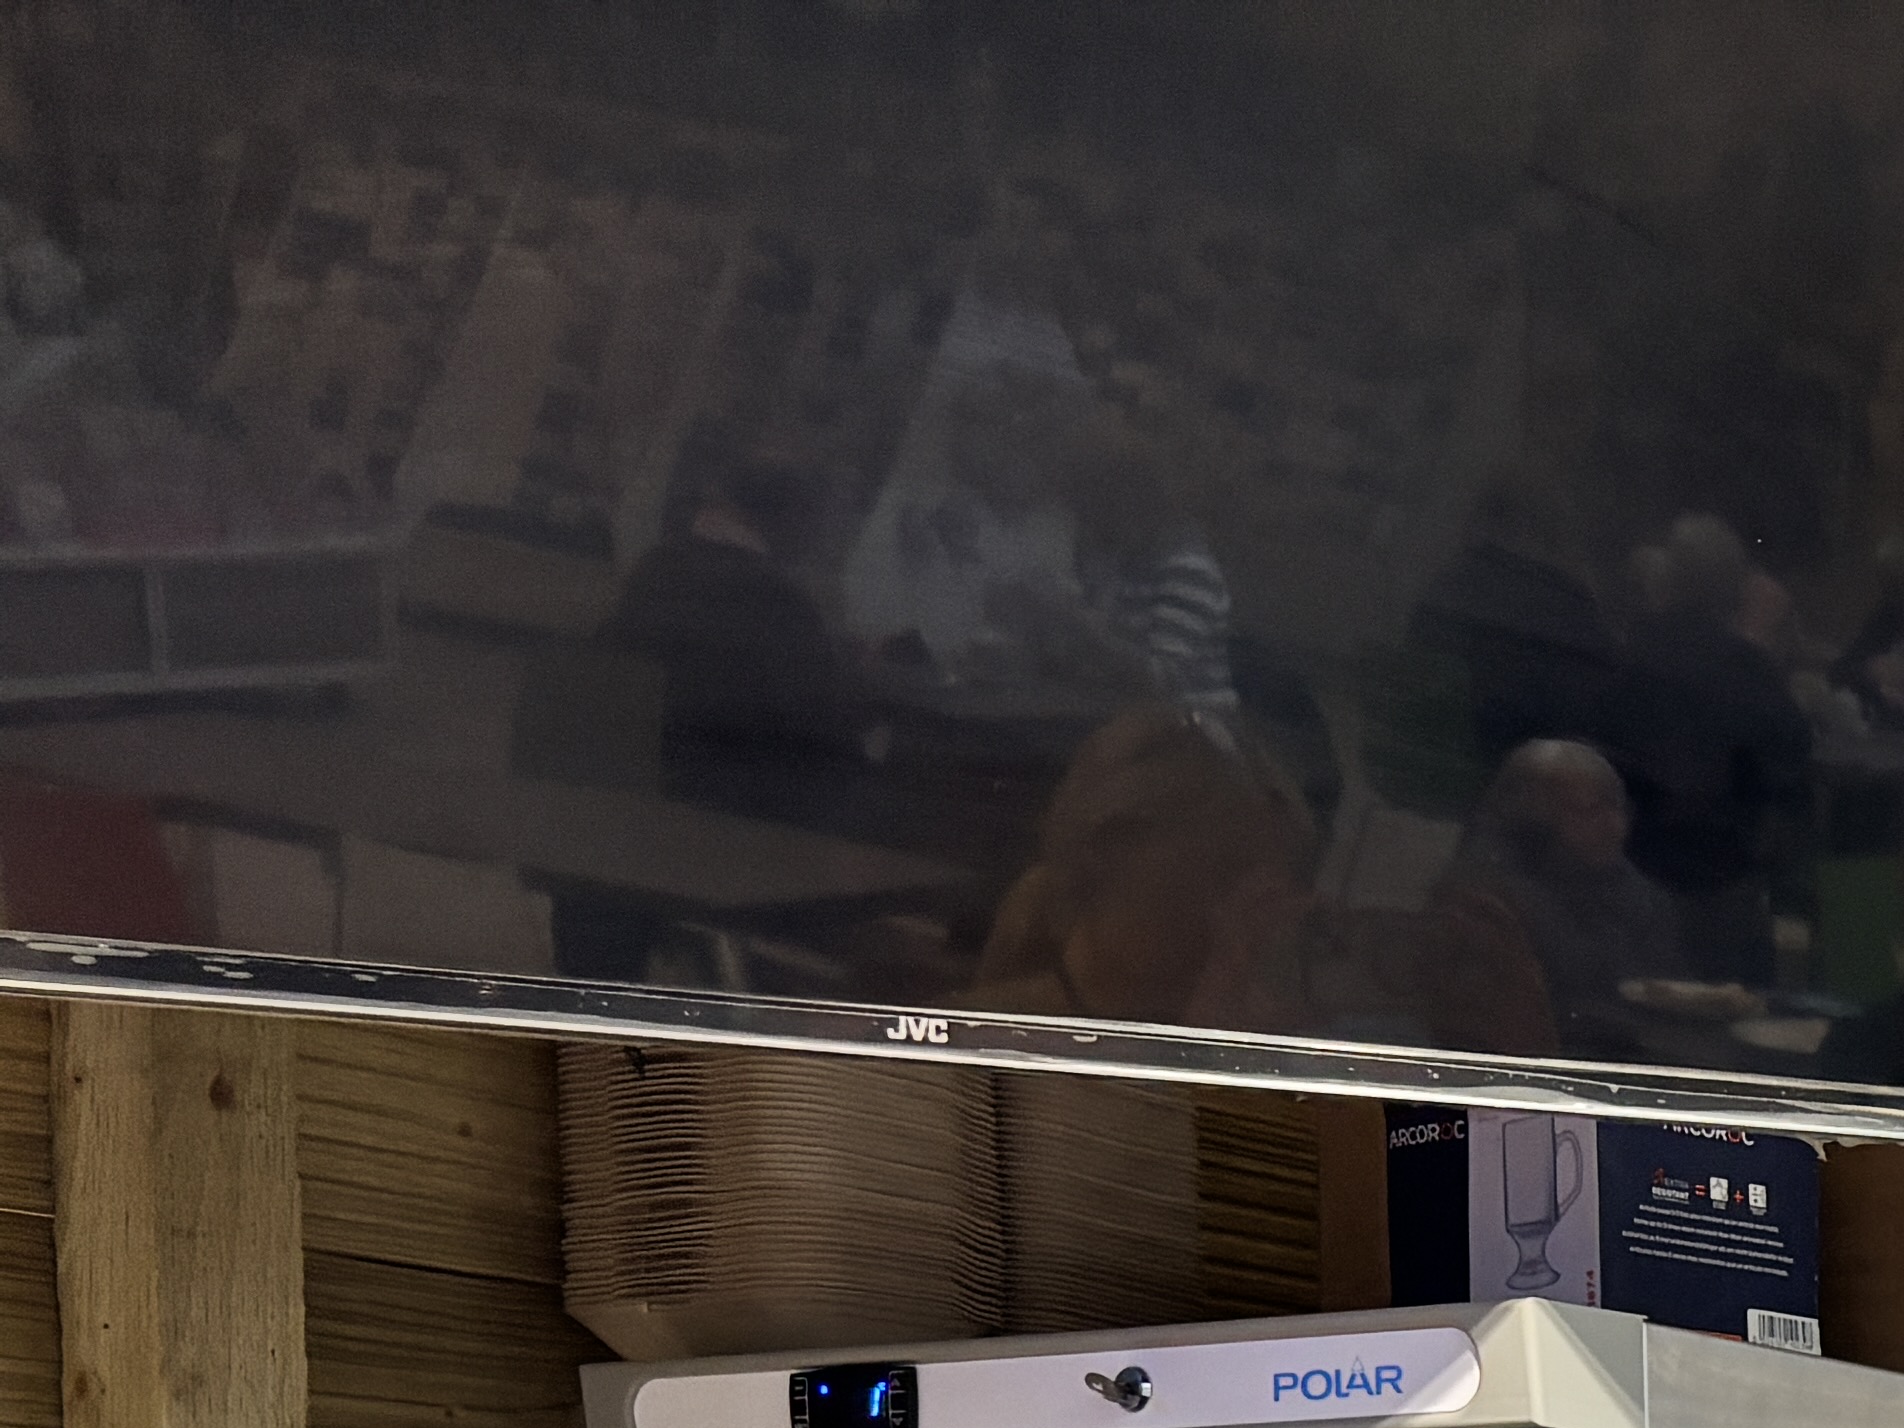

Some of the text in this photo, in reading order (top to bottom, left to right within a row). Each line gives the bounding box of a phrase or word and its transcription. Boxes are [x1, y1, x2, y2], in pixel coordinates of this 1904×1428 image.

[886, 1016, 948, 1043] JVC
[1389, 1120, 1465, 1148] ARCOROC
[1273, 1365, 1404, 1402] POLAR
